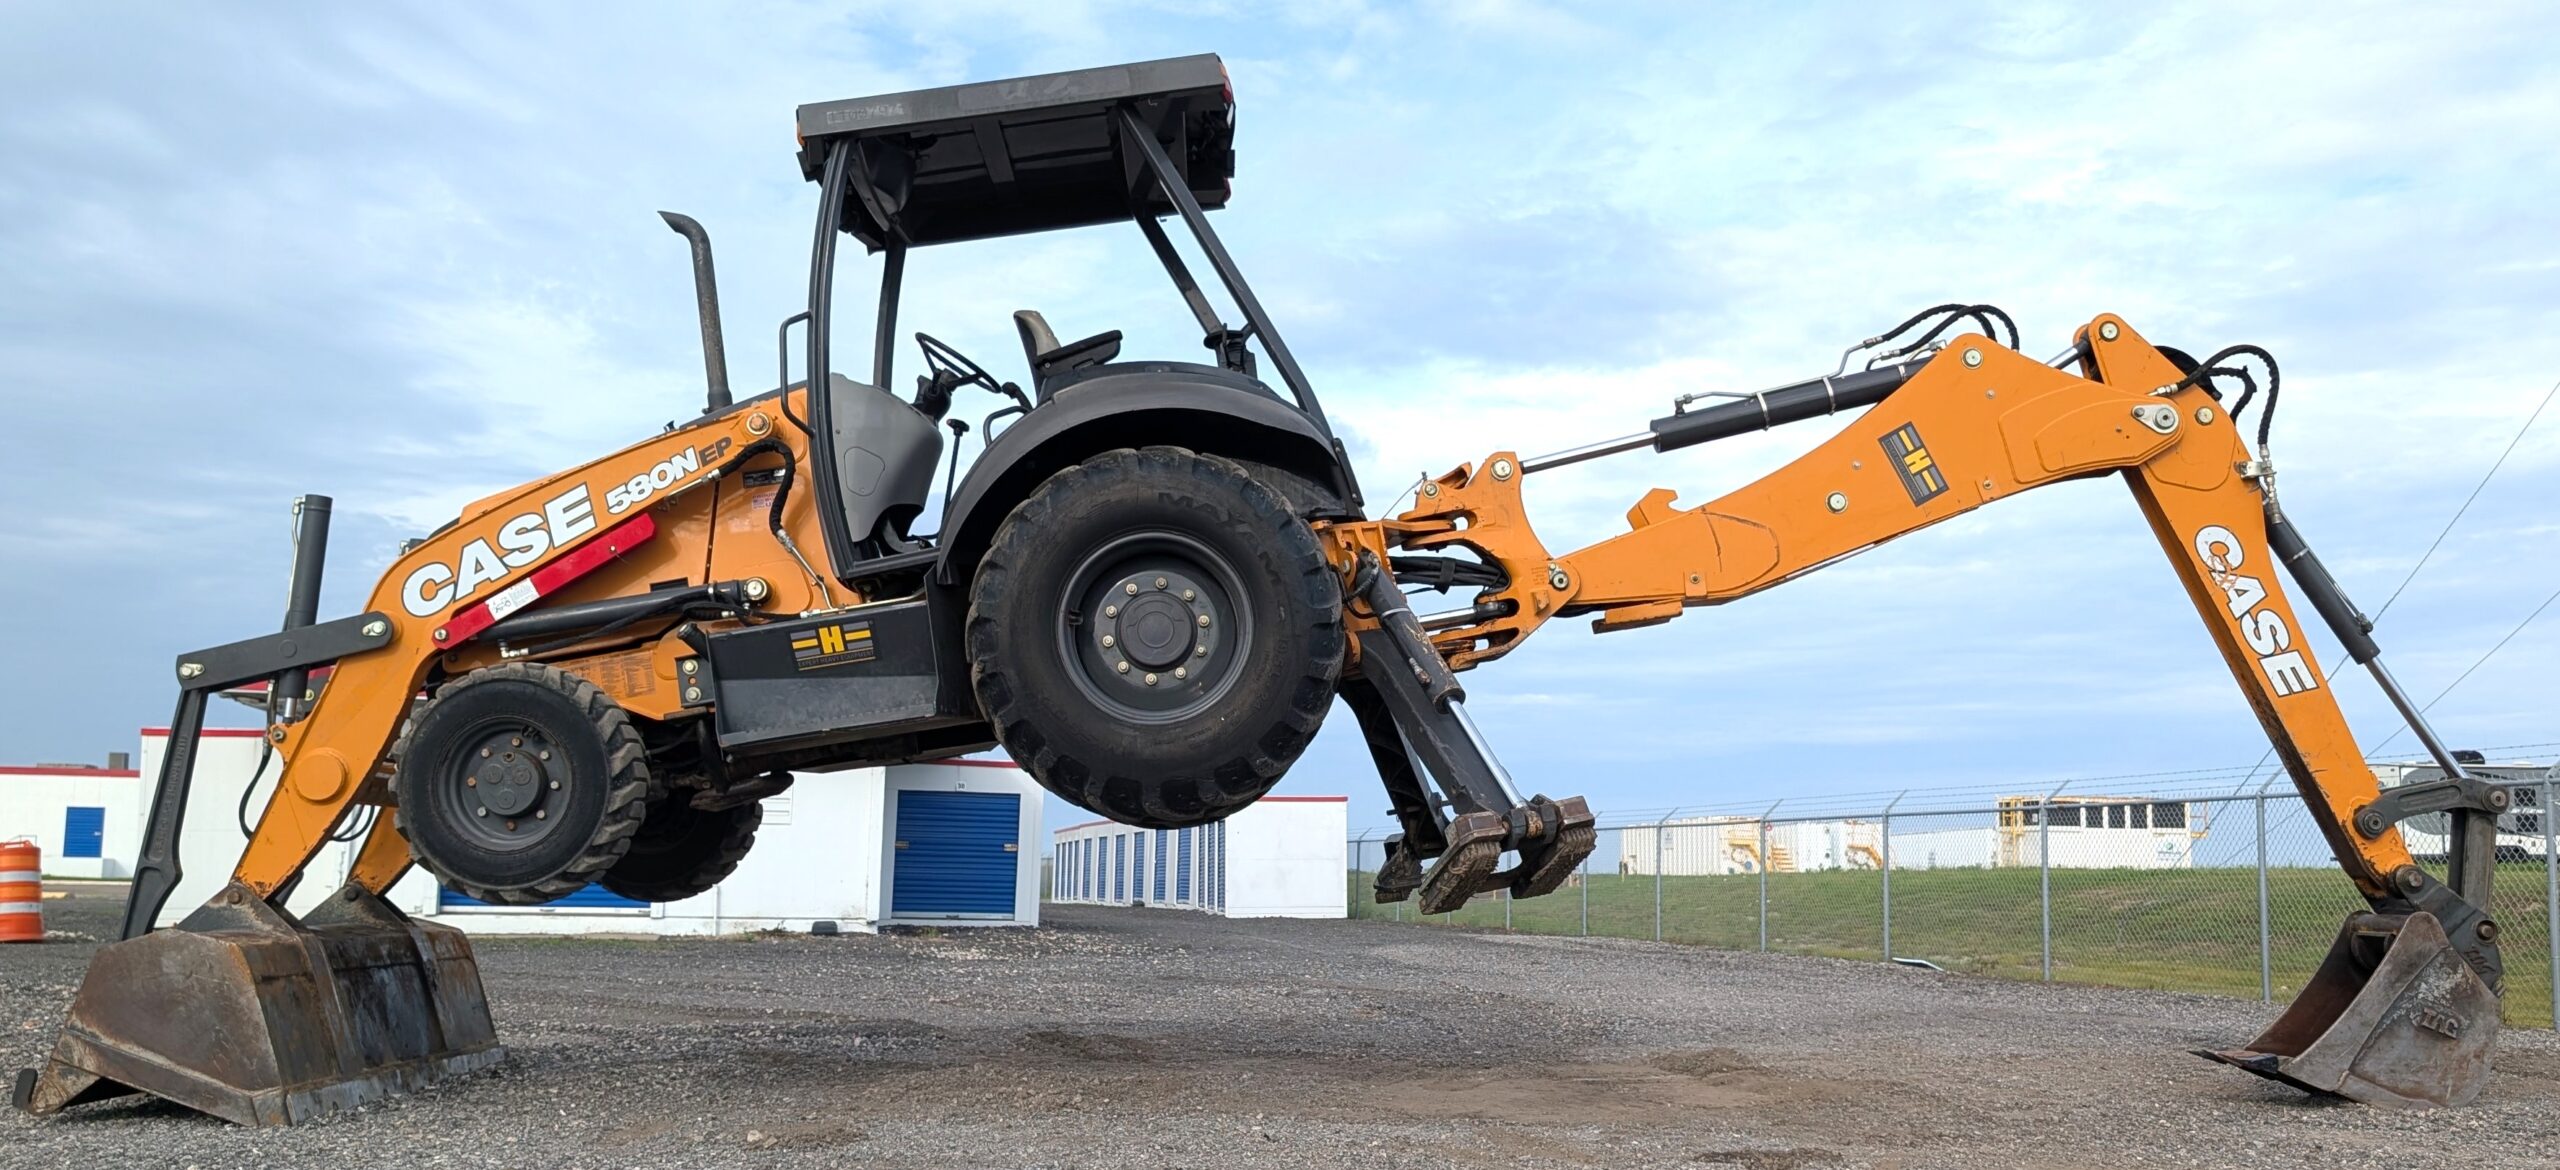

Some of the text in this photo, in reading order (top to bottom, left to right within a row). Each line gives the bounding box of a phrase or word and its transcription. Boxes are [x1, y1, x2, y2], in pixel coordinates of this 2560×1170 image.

[1904, 447, 1933, 474] H
[402, 482, 597, 618] CASE
[818, 625, 845, 654] H
[2194, 524, 2320, 698] CASE
